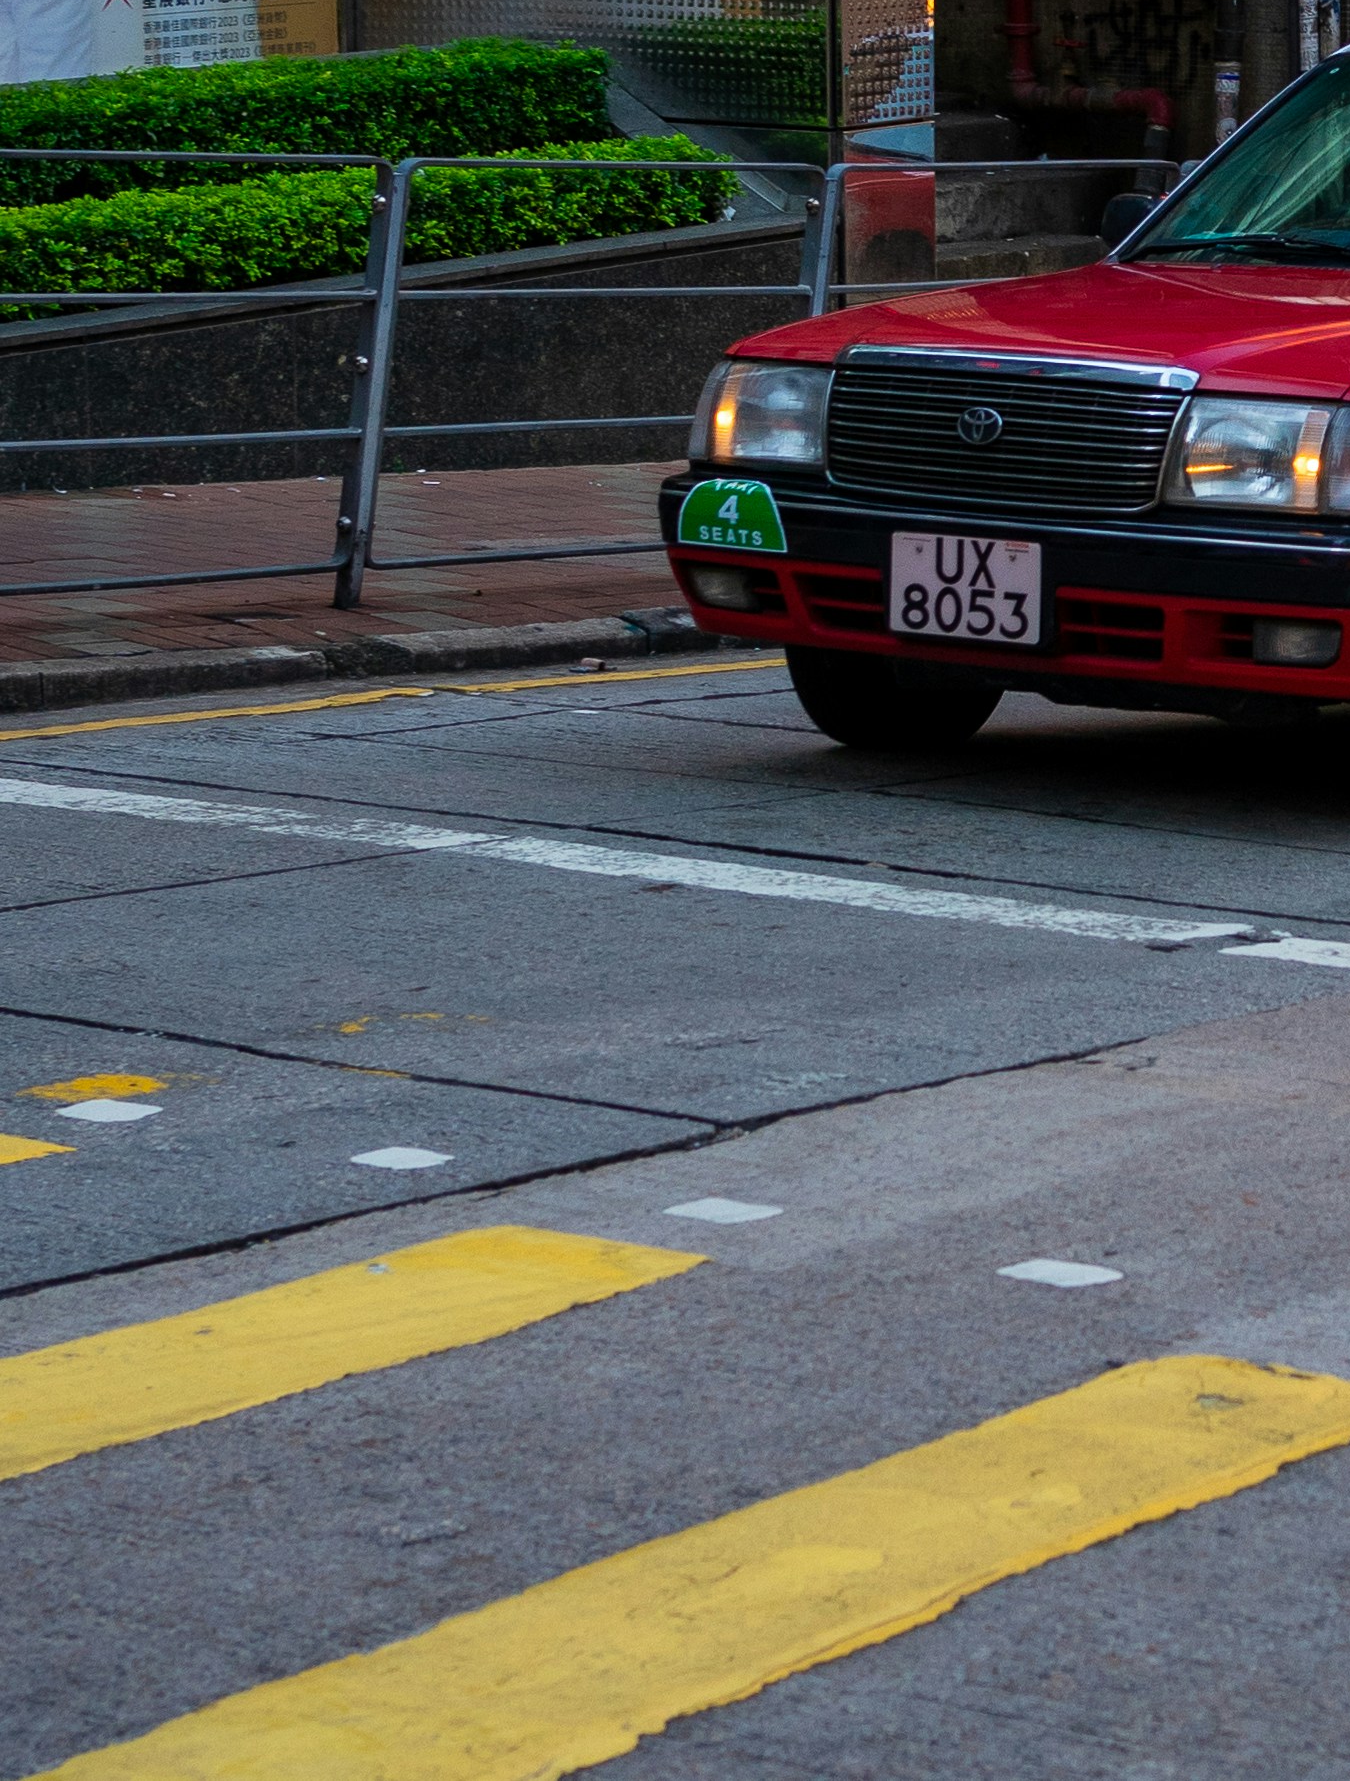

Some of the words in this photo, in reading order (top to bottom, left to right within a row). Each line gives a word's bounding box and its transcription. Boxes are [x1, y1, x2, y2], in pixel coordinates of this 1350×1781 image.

[718, 494, 739, 524] 4
[699, 524, 763, 546] SEATS
[935, 536, 997, 590] UX
[900, 582, 1030, 640] 8053
